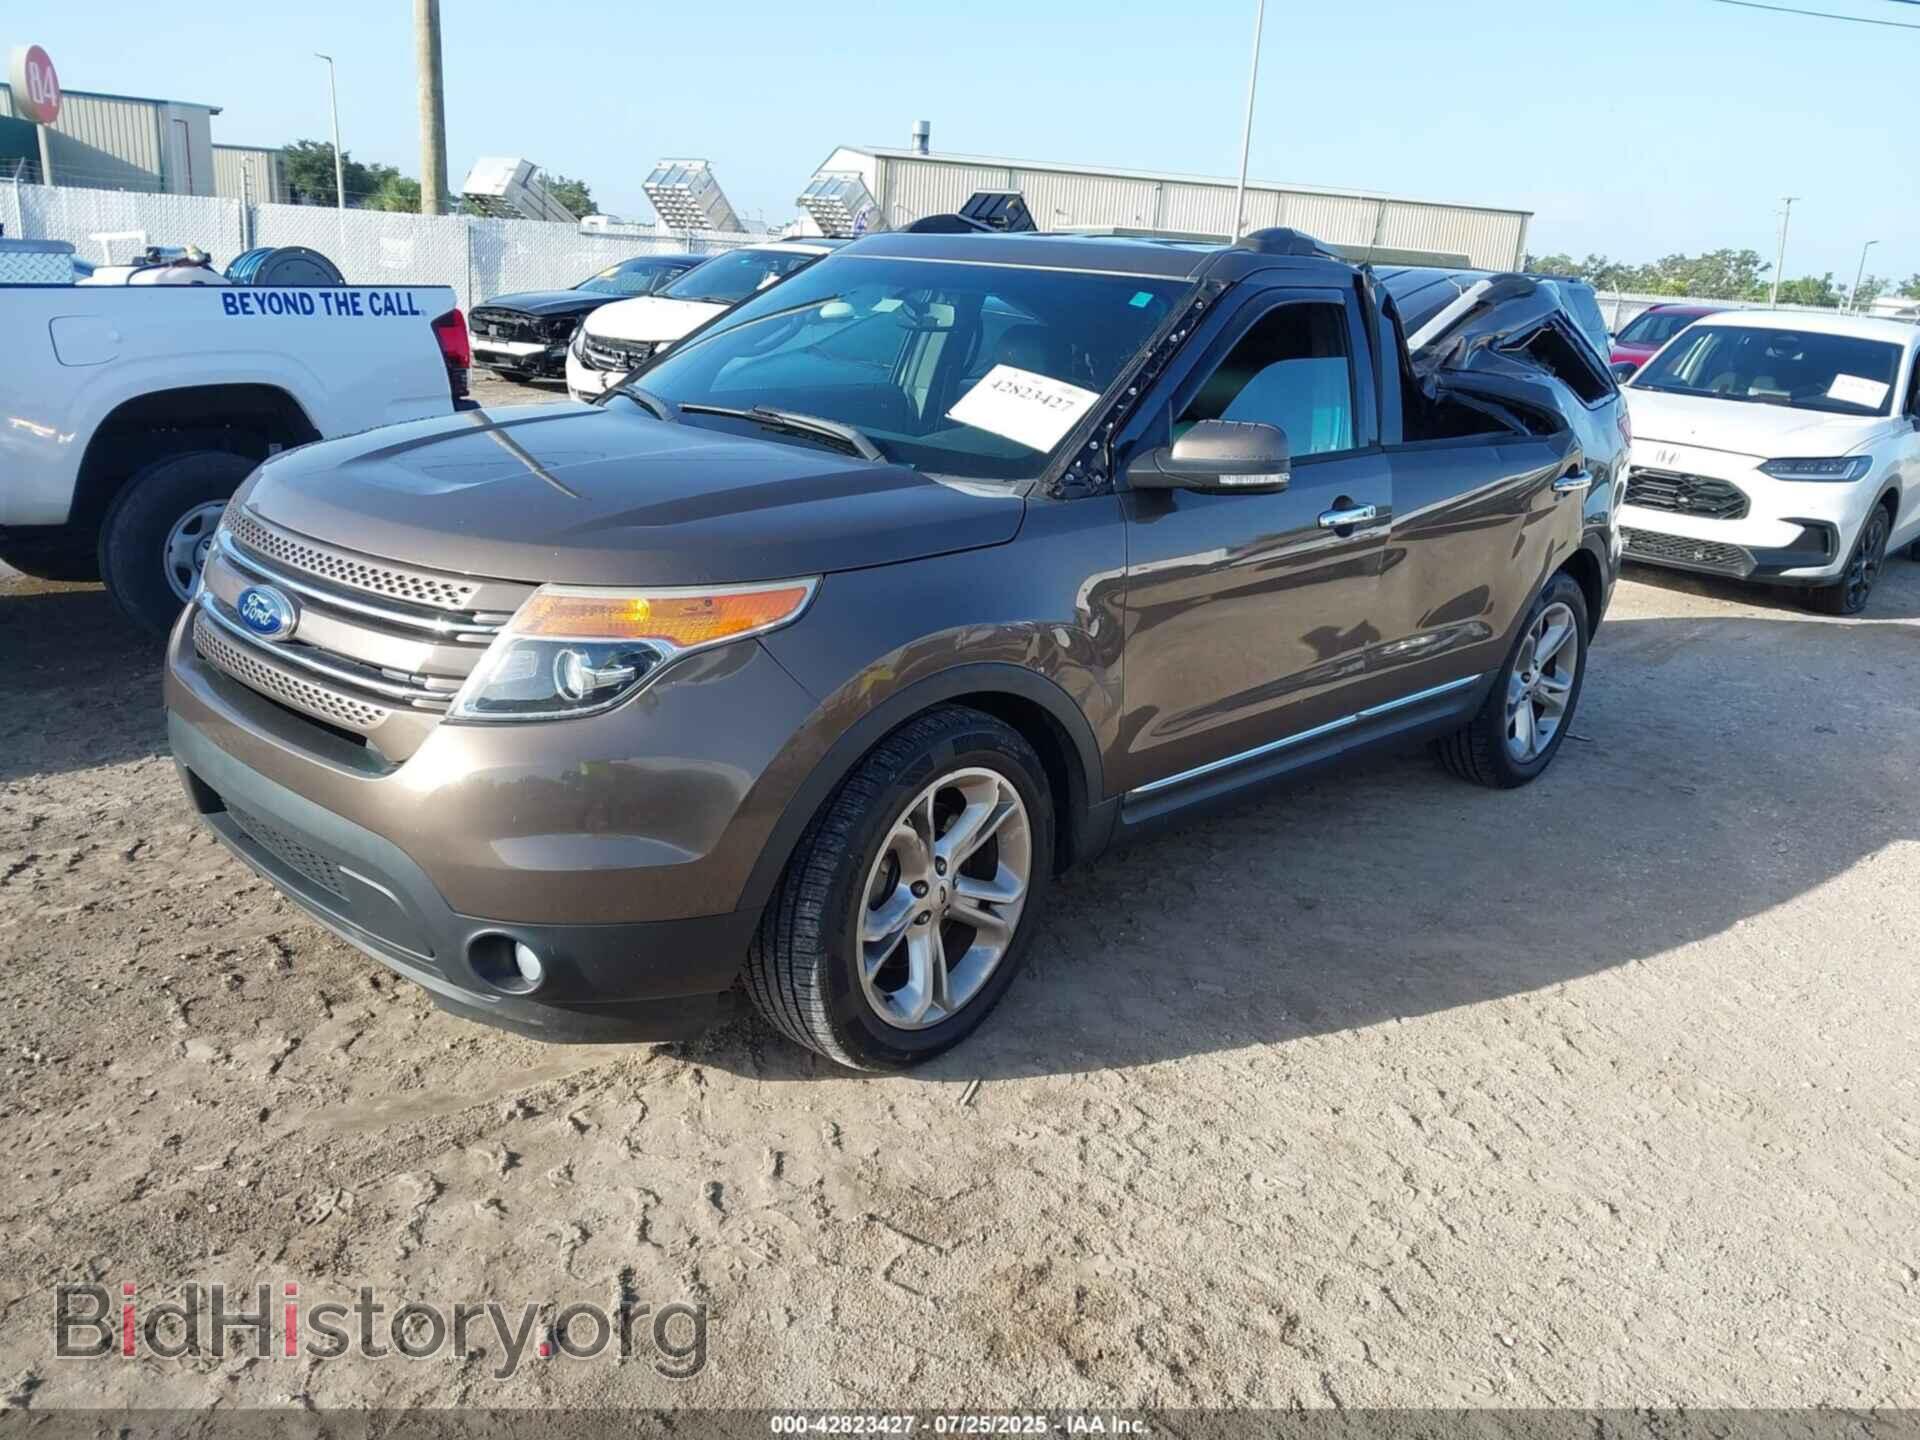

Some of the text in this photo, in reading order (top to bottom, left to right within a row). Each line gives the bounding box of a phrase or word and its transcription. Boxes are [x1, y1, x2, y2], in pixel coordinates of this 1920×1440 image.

[29, 61, 57, 107] 84
[221, 292, 421, 316] BEYOND THE CALL
[992, 380, 1075, 412] 42823427
[242, 592, 275, 626] Ford
